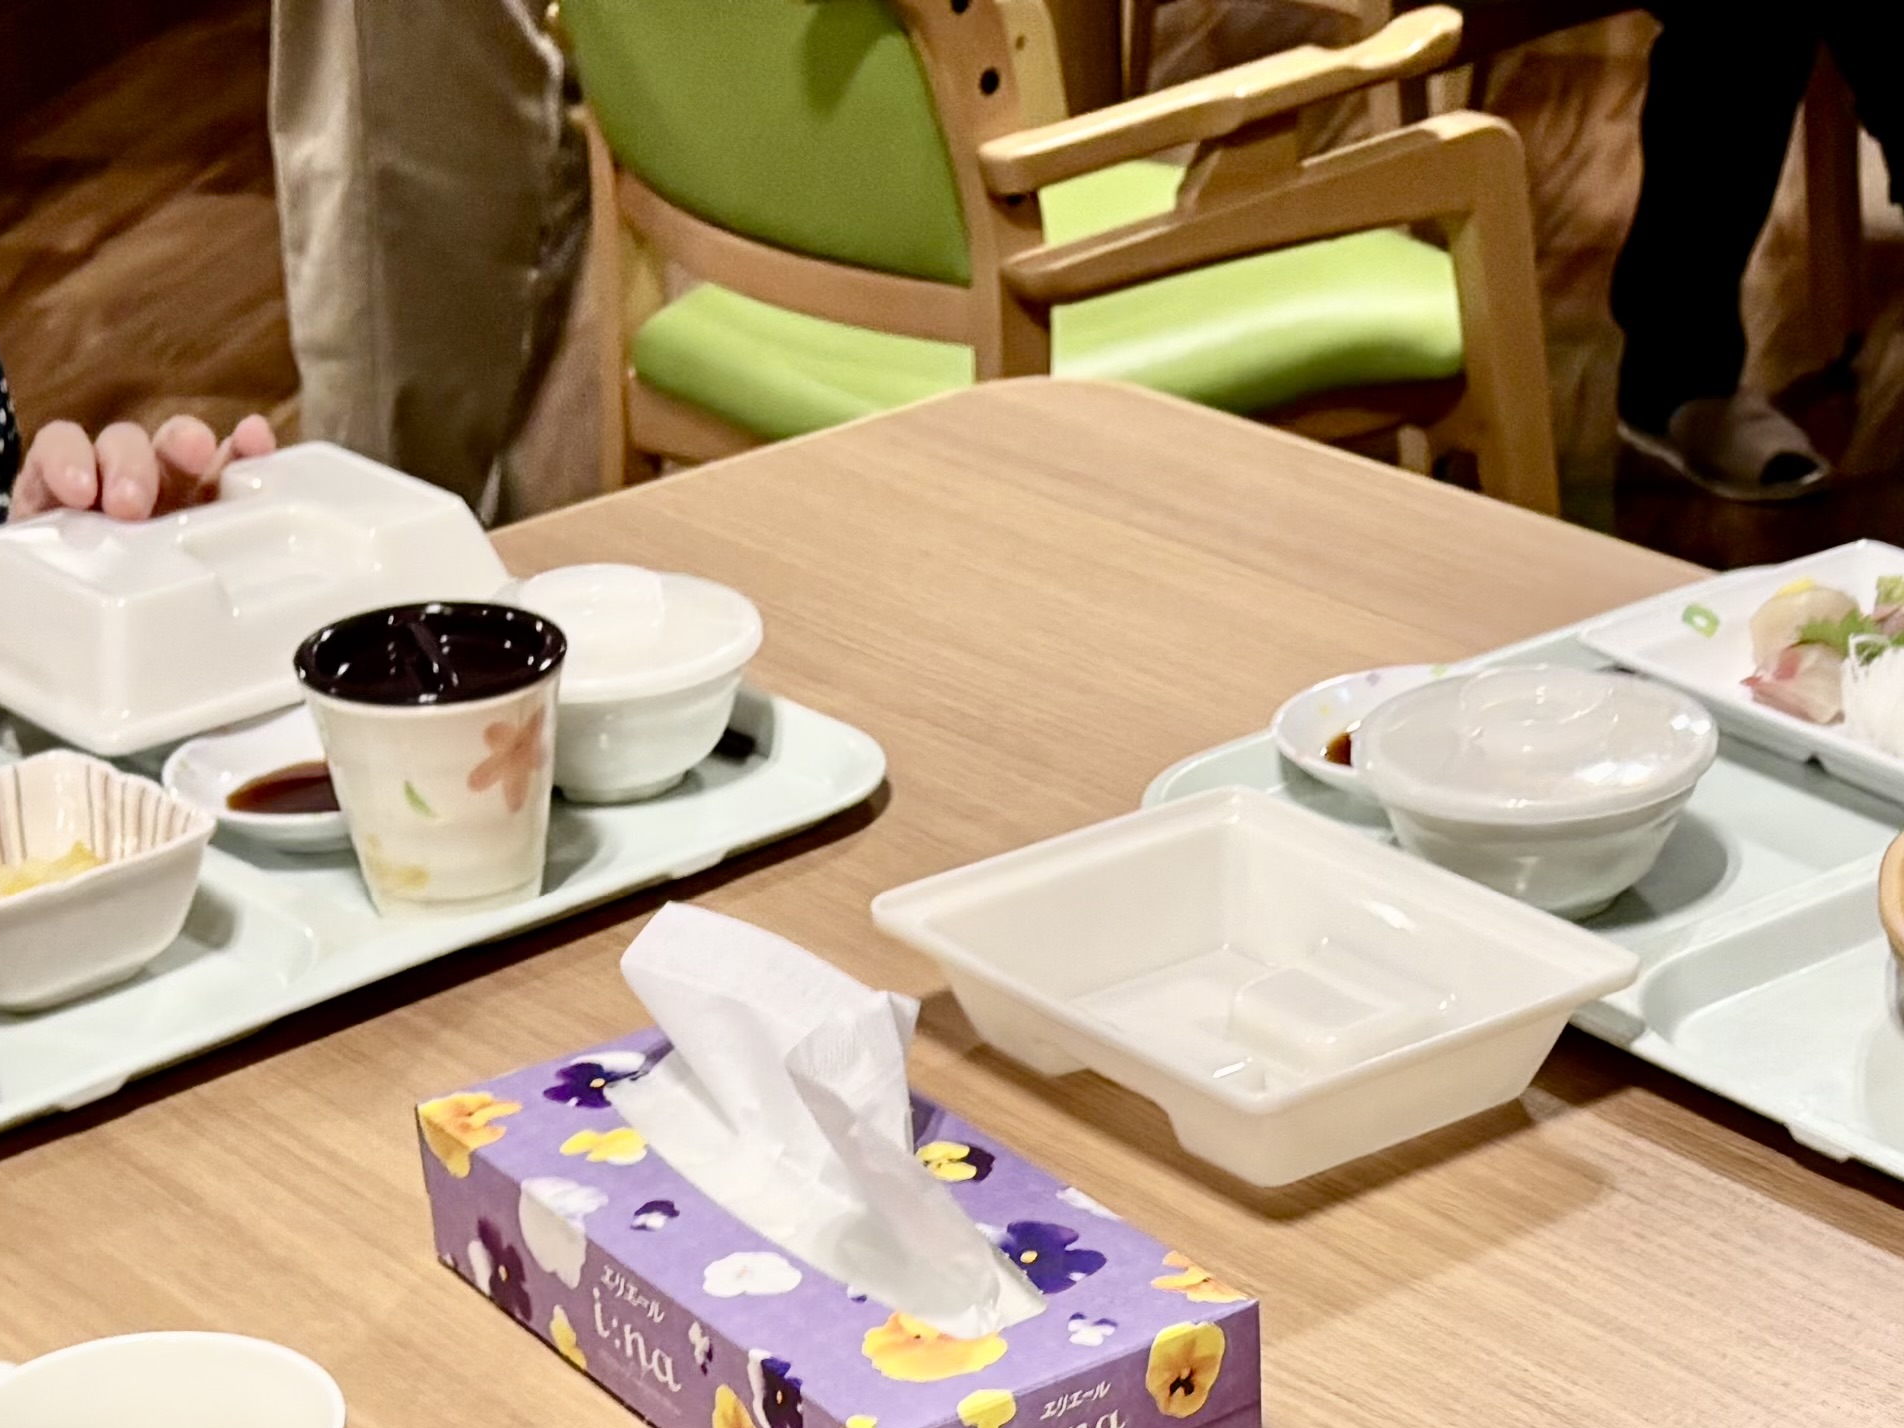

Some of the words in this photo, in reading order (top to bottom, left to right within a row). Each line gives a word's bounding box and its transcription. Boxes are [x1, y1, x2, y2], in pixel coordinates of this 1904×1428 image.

[593, 1287, 682, 1393] i:na
[1040, 1381, 1112, 1421] エリエール
